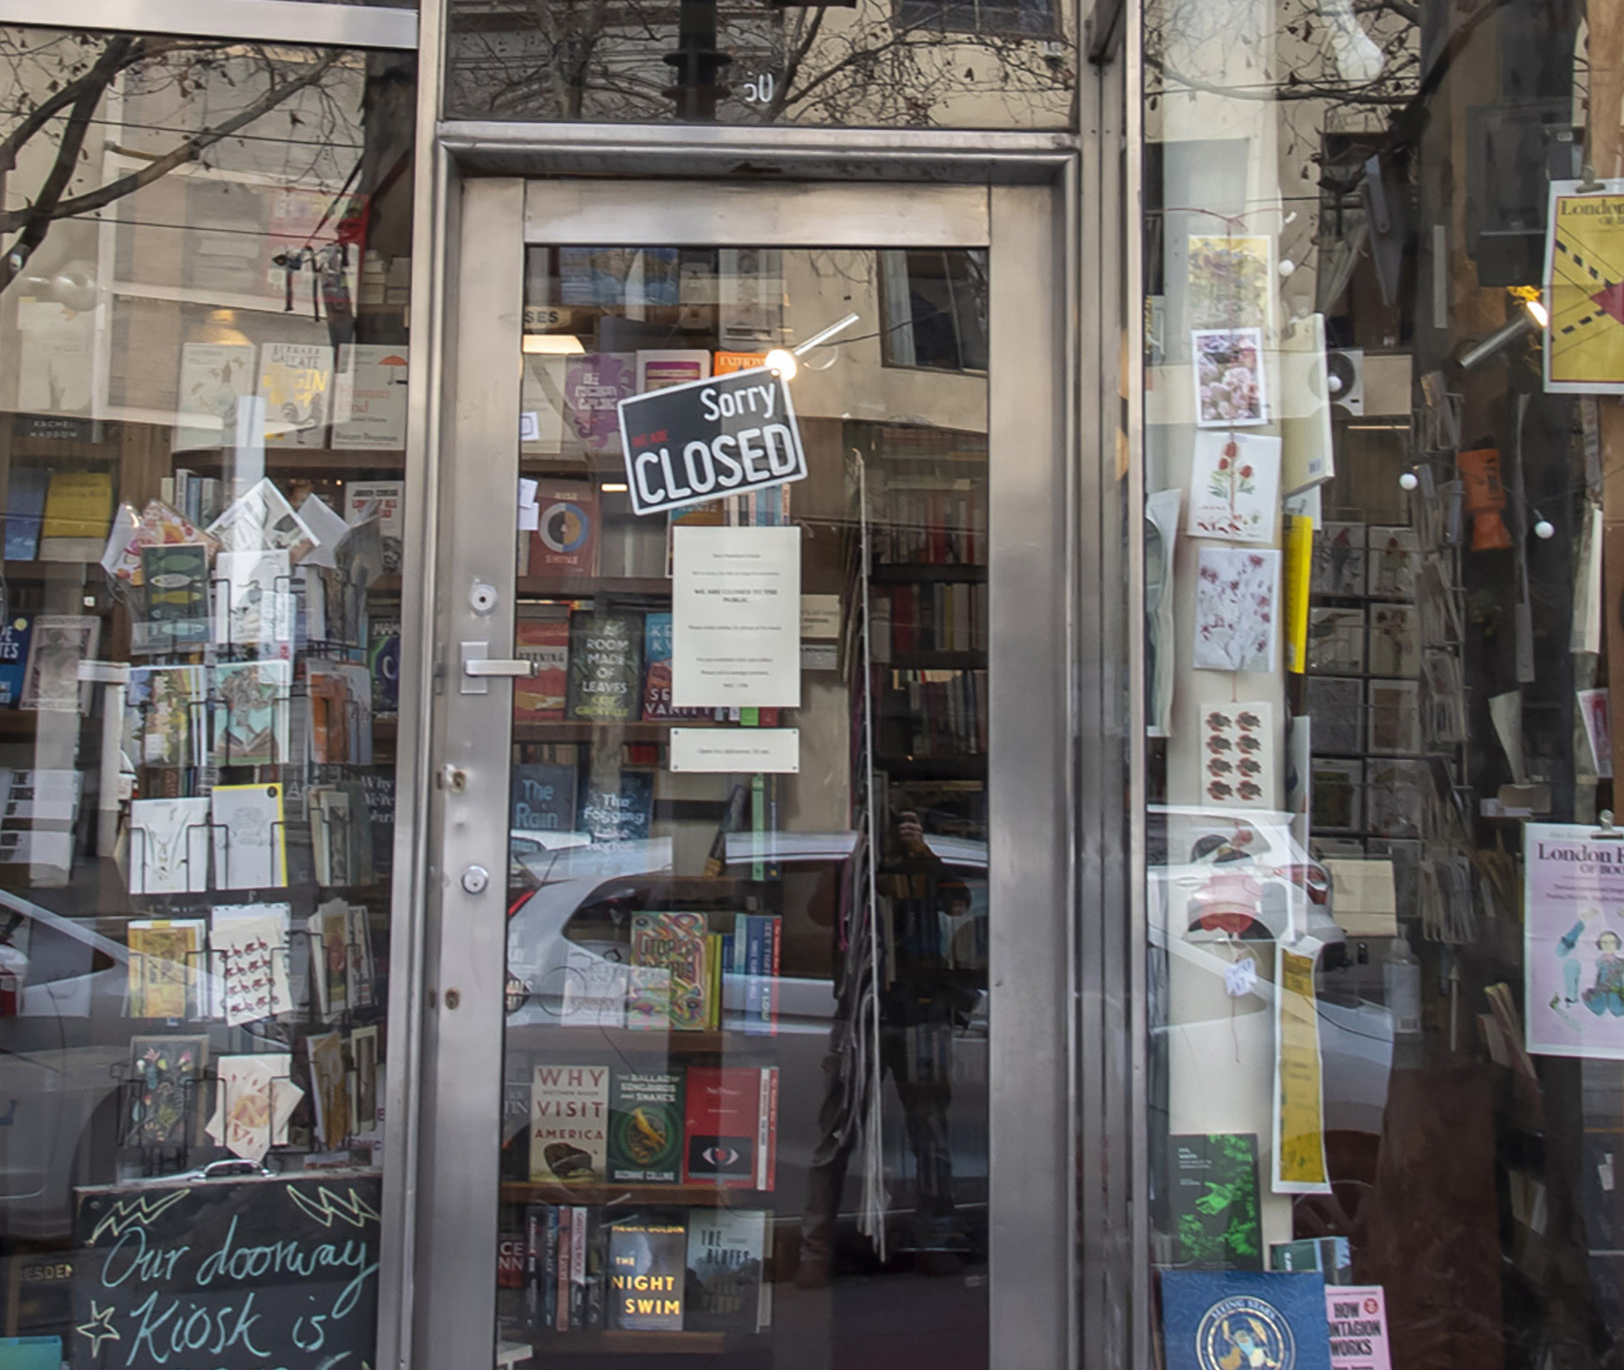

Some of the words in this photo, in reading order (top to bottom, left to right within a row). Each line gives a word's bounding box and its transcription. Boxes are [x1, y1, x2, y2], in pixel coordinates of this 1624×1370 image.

[699, 382, 776, 422] Sorry
[634, 423, 798, 504] CLOSED
[586, 639, 630, 651] ROOM
[586, 653, 627, 665] MADE
[595, 668, 617, 679] OF
[581, 681, 629, 693] LEAVES
[522, 779, 554, 800] The
[515, 803, 558, 829] Rain
[582, 806, 646, 824] Fogging
[1538, 843, 1612, 864] London
[1580, 865, 1595, 875] OF
[538, 1068, 606, 1088] WHY
[630, 1074, 670, 1083] BALLAD
[620, 1082, 677, 1093] SONGBIRDS
[636, 1091, 676, 1102] SNAKES
[536, 1100, 604, 1119] VISIT
[534, 1128, 605, 1141] AMERICA
[700, 1229, 722, 1247] THE
[101, 1226, 191, 1288] Our
[196, 1214, 381, 1320] doorway
[615, 1256, 636, 1266] THE
[611, 1275, 675, 1292] NIGHT
[624, 1299, 681, 1315] SWIM
[1332, 1302, 1360, 1319] HOW
[125, 1290, 273, 1367] Kiosk
[292, 1295, 329, 1352] is
[1330, 1339, 1373, 1358] WORKS
